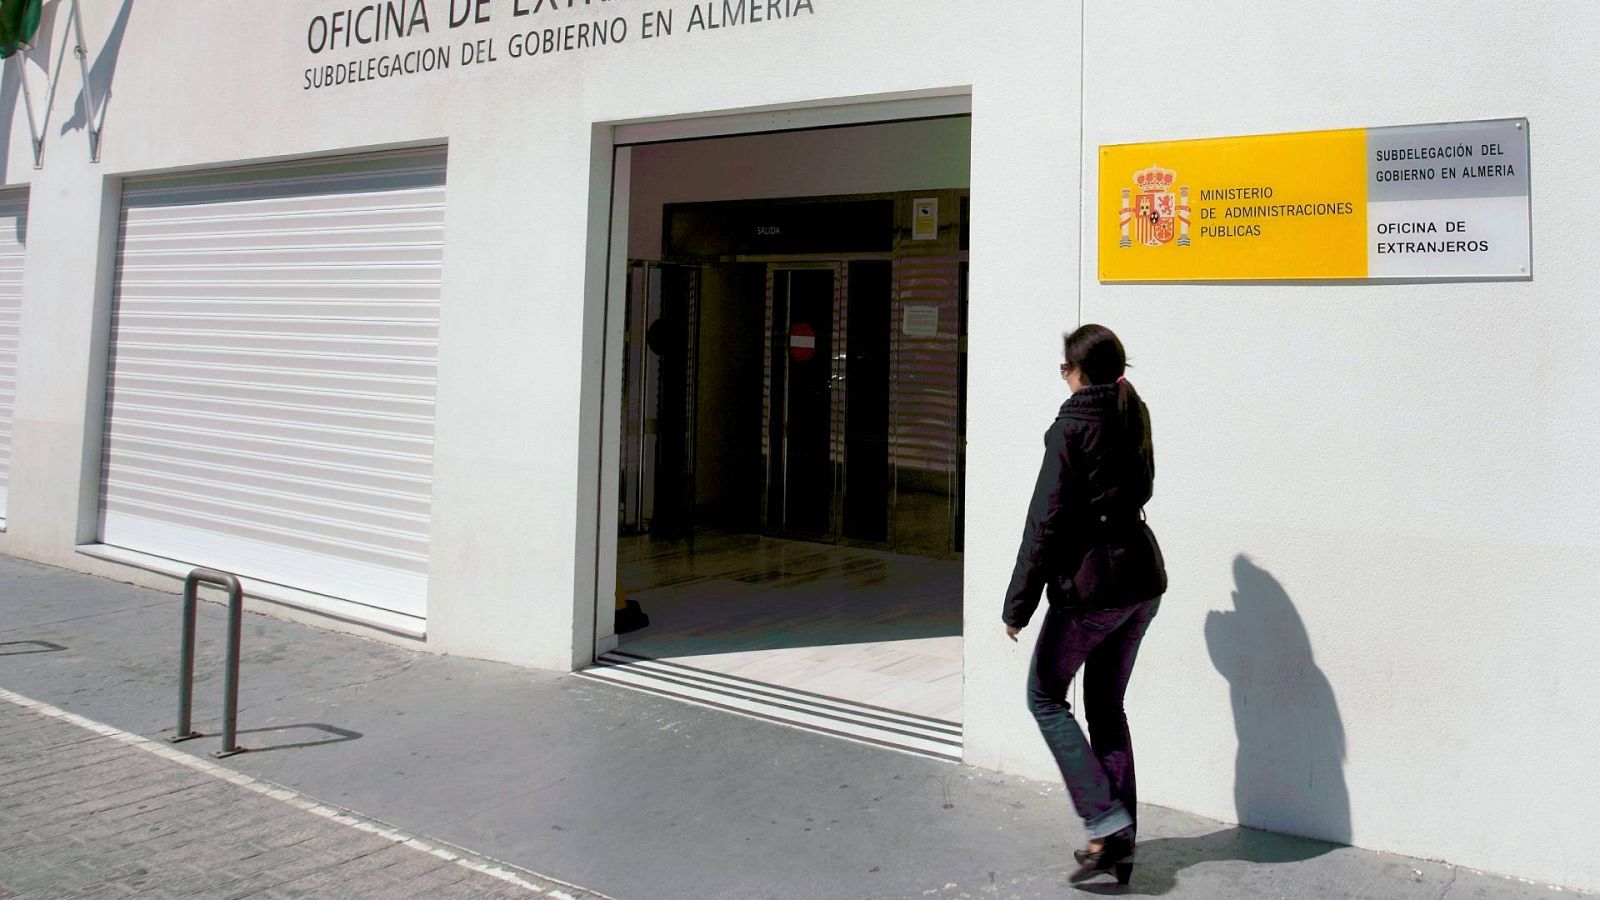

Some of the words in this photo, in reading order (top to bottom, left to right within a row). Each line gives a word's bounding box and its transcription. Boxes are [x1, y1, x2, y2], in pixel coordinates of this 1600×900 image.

[307, 0, 430, 54] OFICINA
[449, 0, 491, 29] DE
[303, 45, 451, 90] SUBDELEGACION
[461, 38, 497, 66] DEL
[508, 17, 627, 58] GOBIERNO
[641, 9, 673, 39] EN
[686, 0, 814, 33] ALMERIA
[1376, 142, 1473, 162] SUBDELEGACIÓN
[1481, 144, 1505, 156] DEL
[1376, 167, 1435, 183] GOBIERNO
[1441, 166, 1457, 180] EN
[1462, 165, 1516, 179] ALMERIA
[1200, 187, 1273, 201] MINISTERIO
[1200, 207, 1218, 220] DE
[1224, 203, 1354, 219] ADMINISTRACIONES
[757, 226, 780, 235] SALIDA
[1200, 223, 1261, 238] PÚBLICAS
[1376, 221, 1437, 236] OFICINA
[1446, 221, 1467, 233] DE
[1377, 240, 1489, 255] EXTRANJEROS
